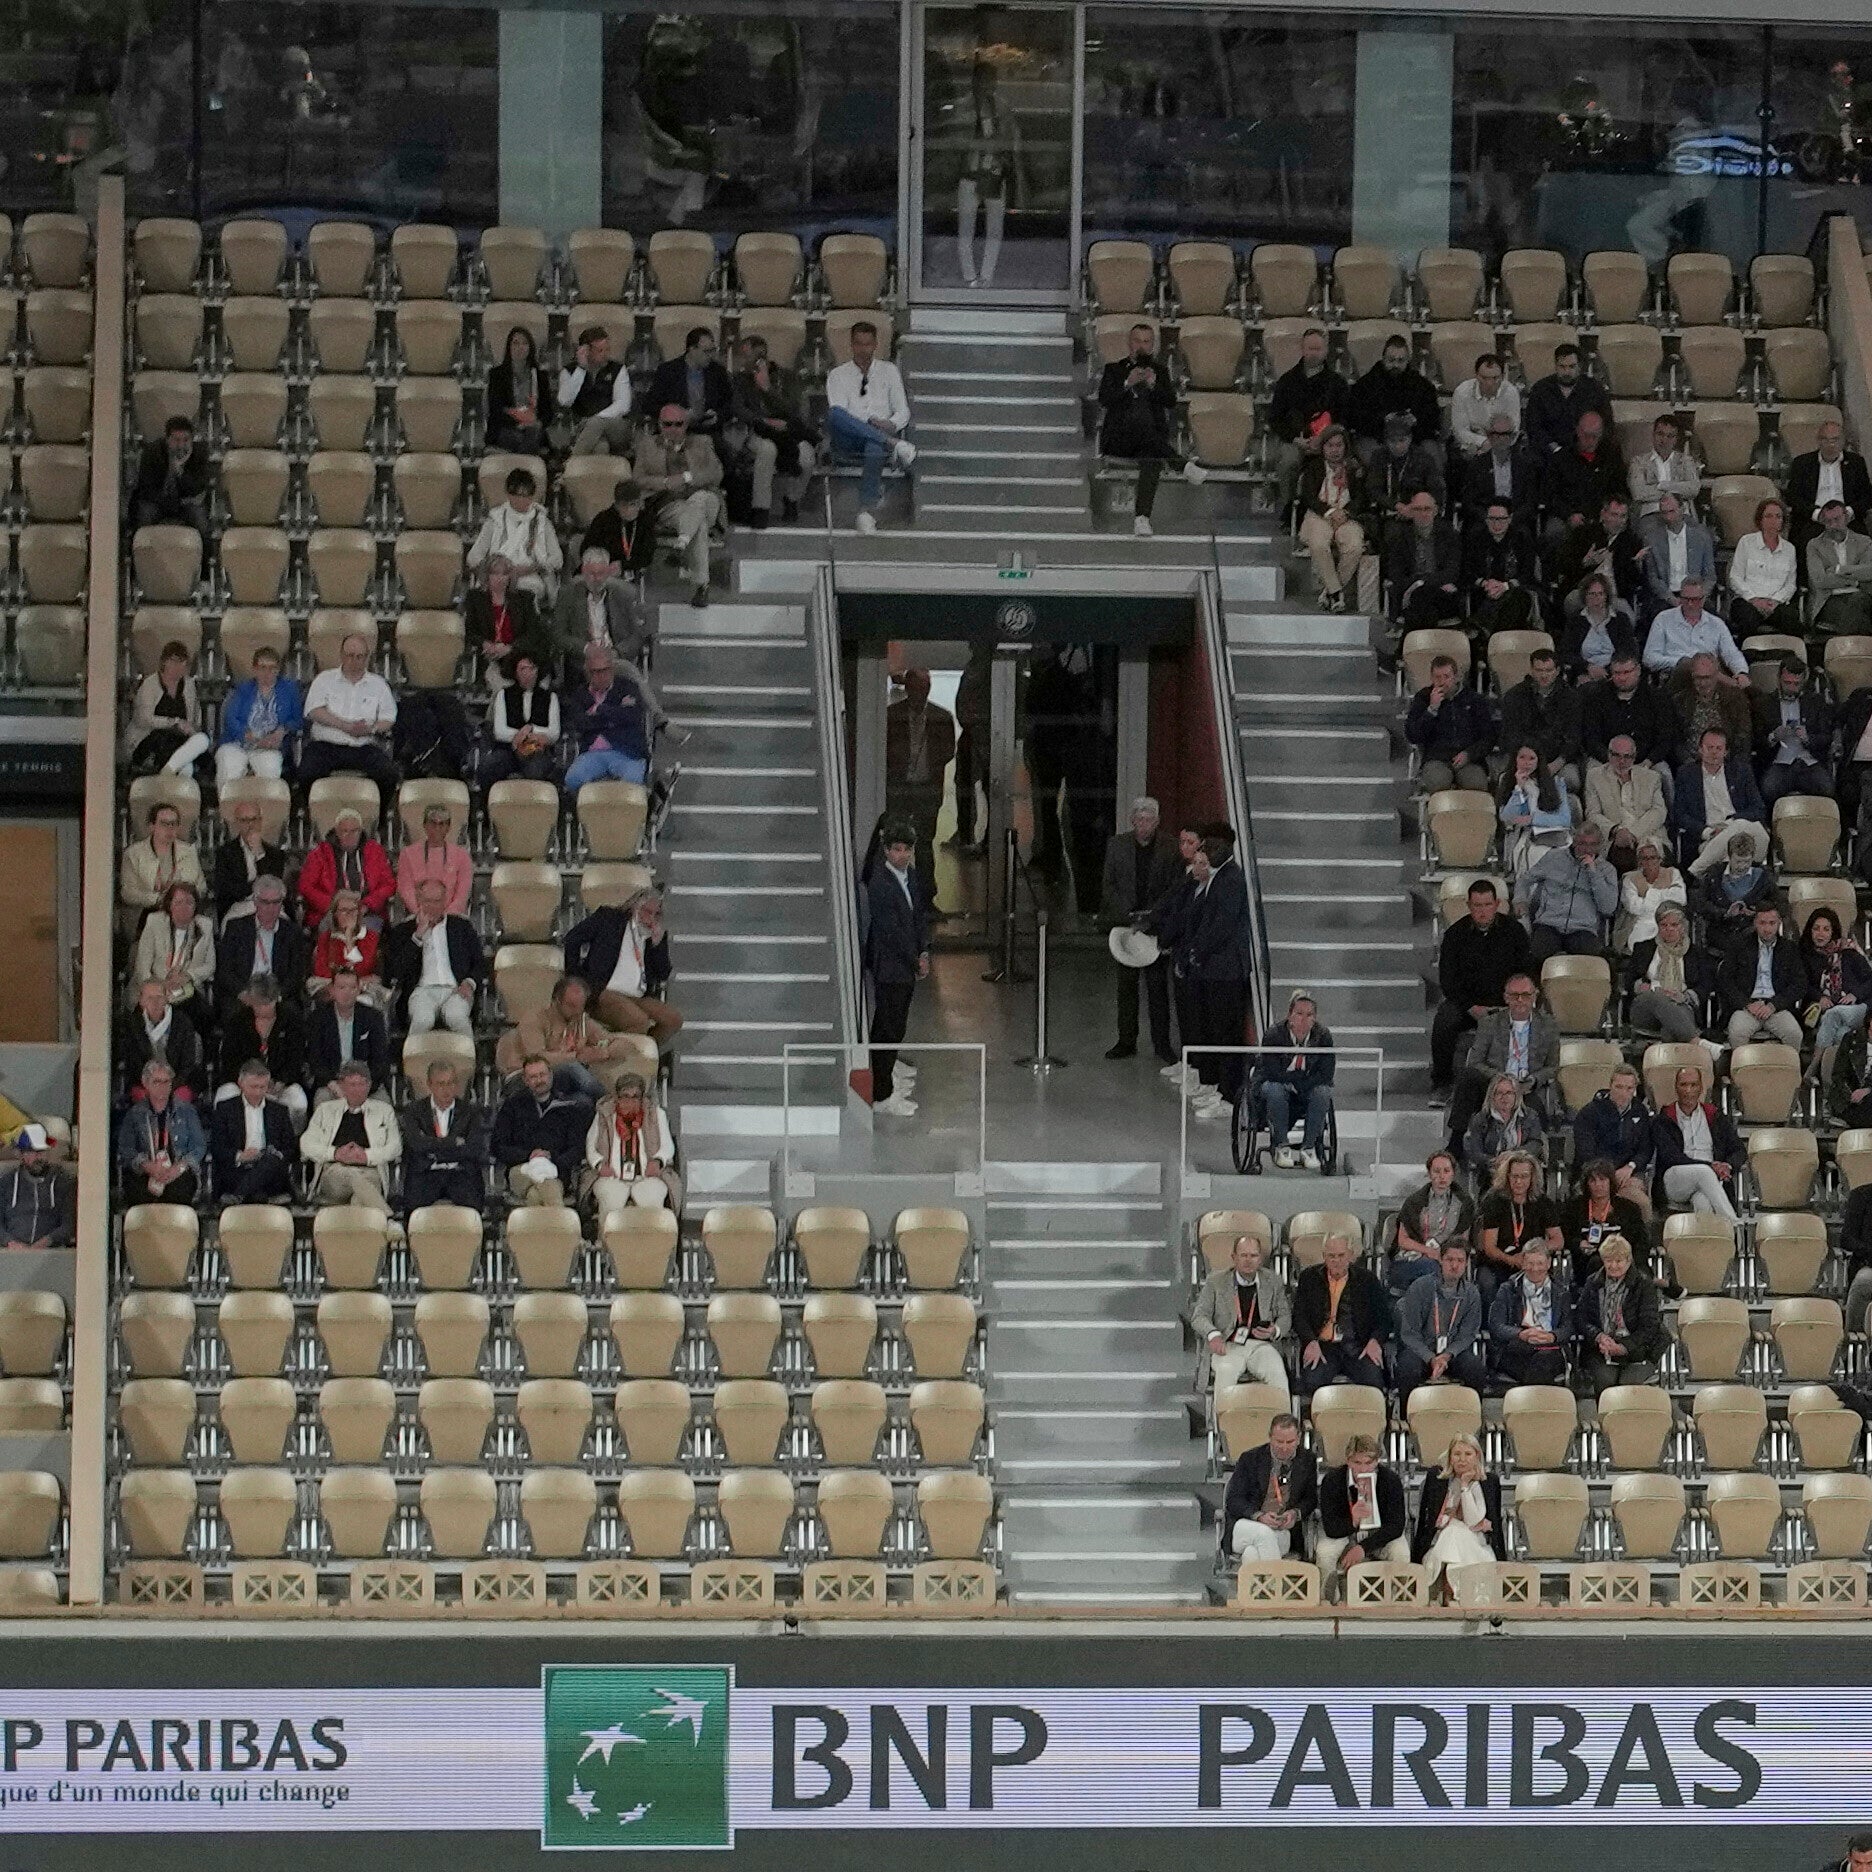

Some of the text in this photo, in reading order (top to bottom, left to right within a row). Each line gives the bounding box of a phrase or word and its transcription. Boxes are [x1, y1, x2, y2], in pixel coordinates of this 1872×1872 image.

[65, 1717, 349, 1772] PARIBAS
[772, 1699, 1762, 1810] BNP PARIBAS
[48, 1780, 102, 1802] d'un
[113, 1780, 201, 1802] monde
[210, 1780, 248, 1808] qui
[259, 1780, 351, 1809] change
